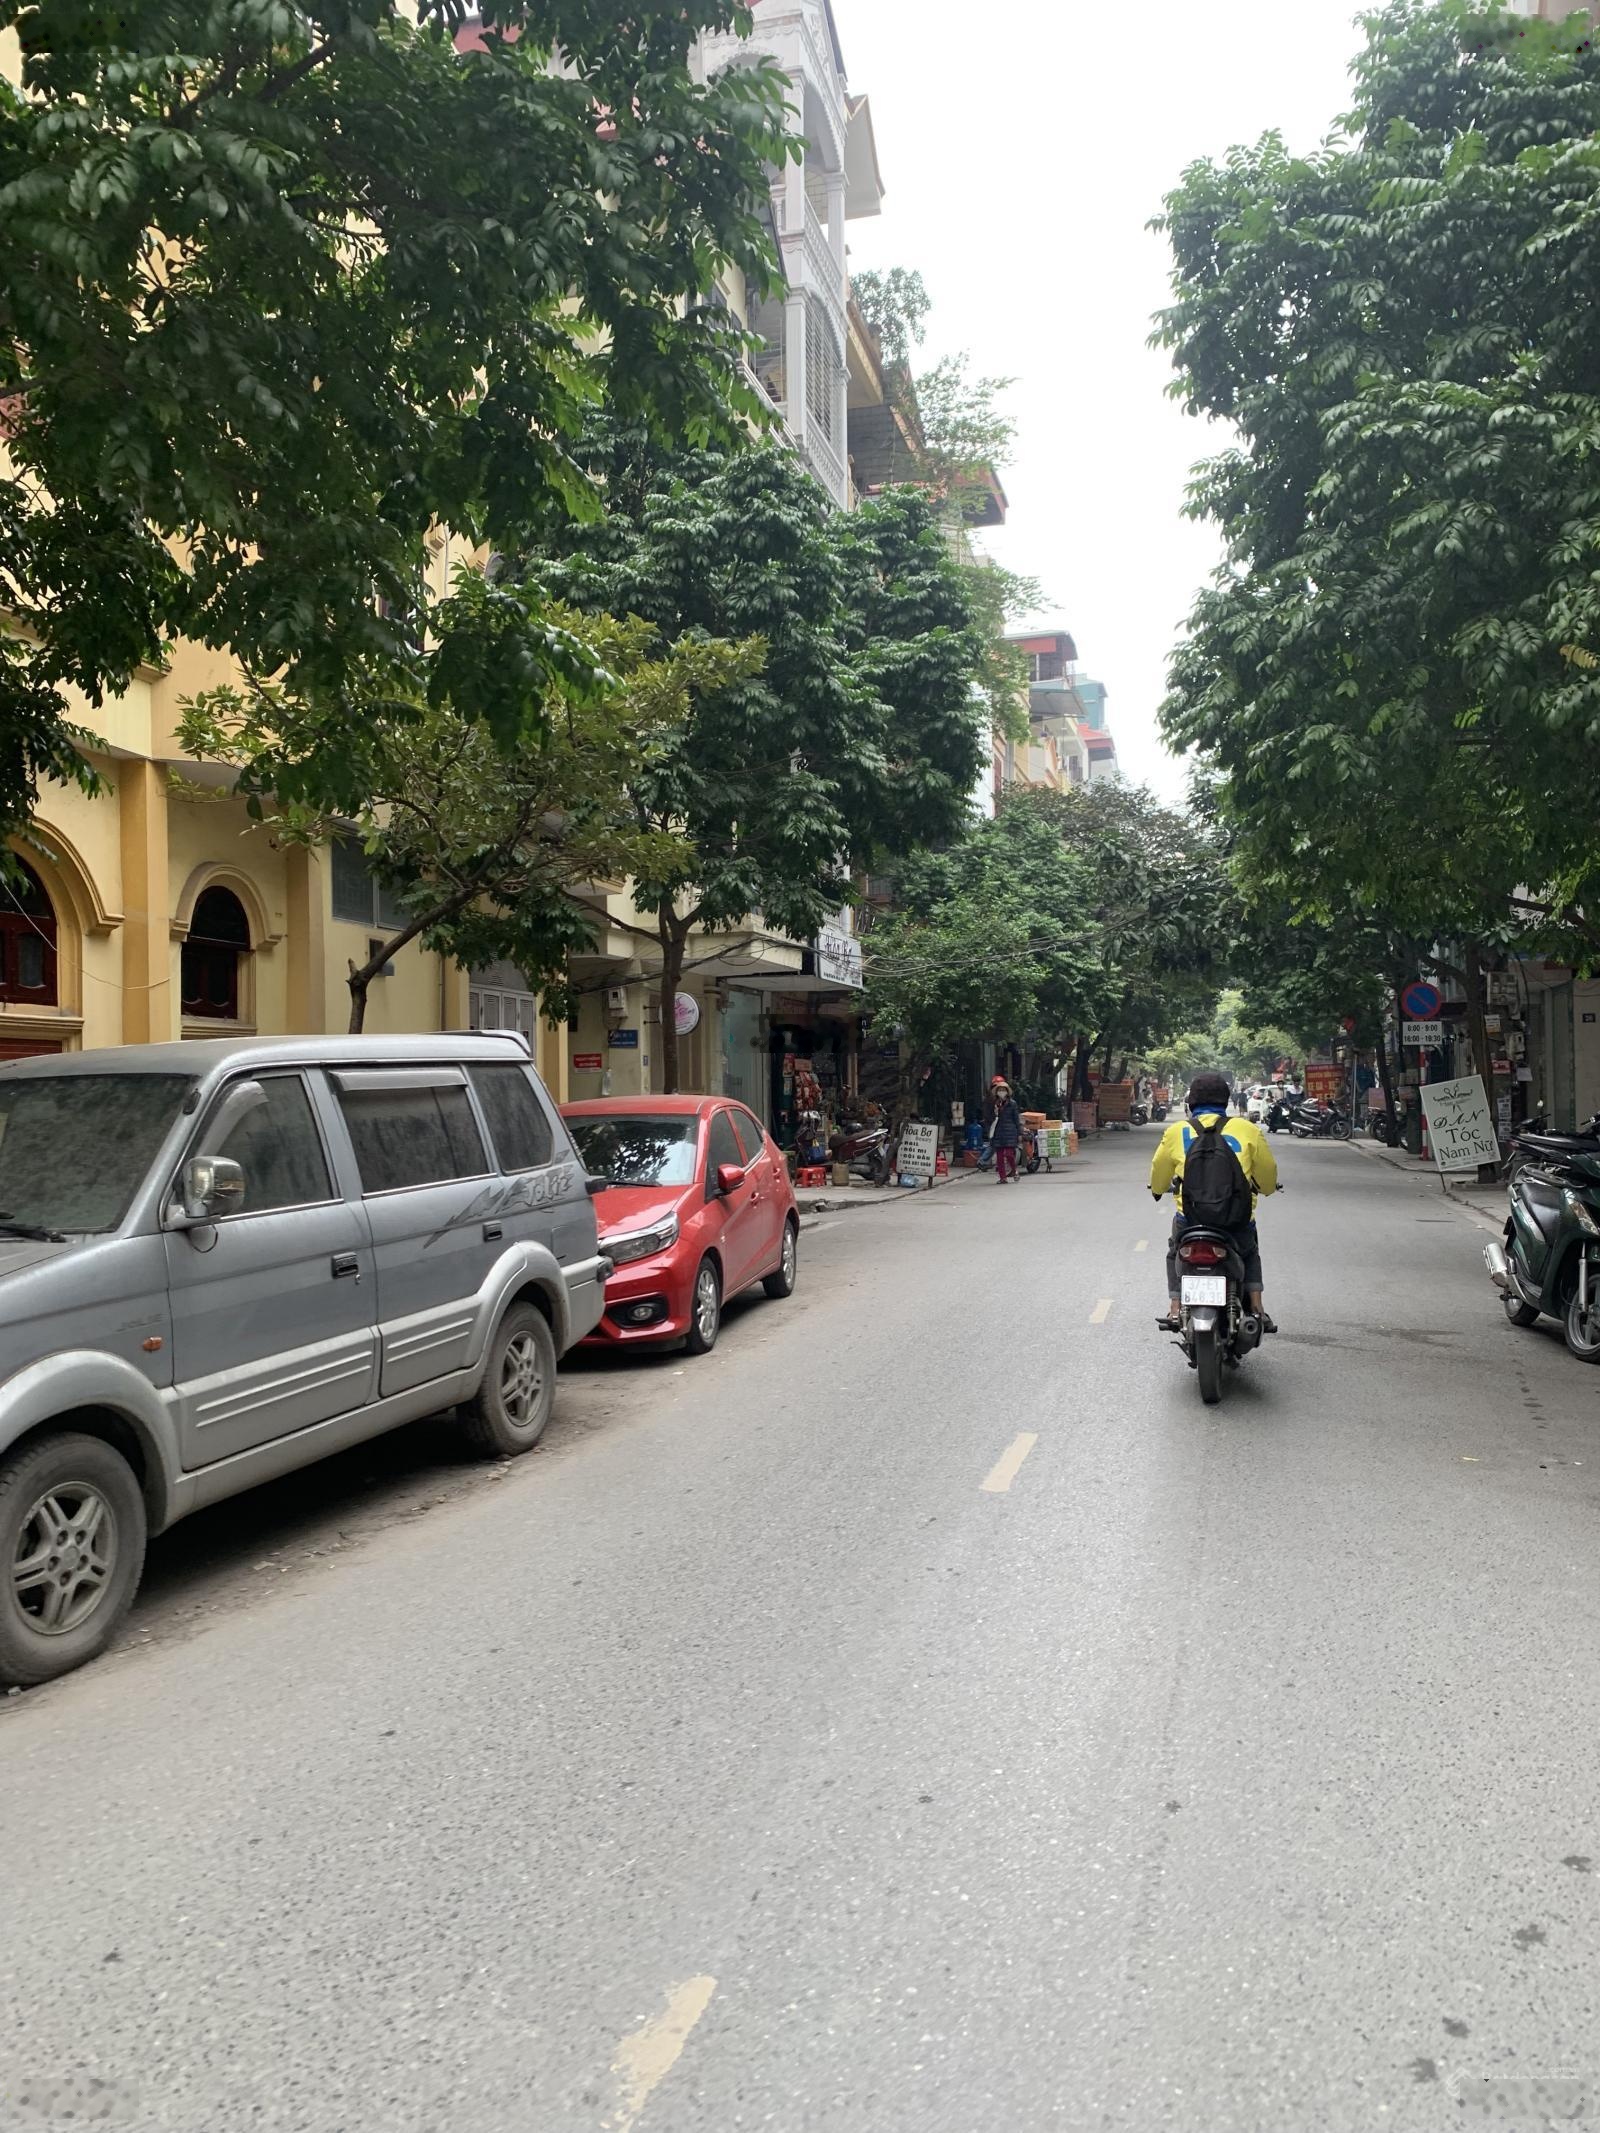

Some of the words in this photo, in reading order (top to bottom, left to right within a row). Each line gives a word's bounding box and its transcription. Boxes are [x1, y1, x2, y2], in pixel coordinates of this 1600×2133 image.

[1425, 1024, 1438, 1032] 9:00
[920, 1126, 932, 1138] Bơ
[1445, 1127, 1481, 1143] Tóc
[1439, 1147, 1470, 1160] Nam
[1473, 1140, 1494, 1154] Nữ
